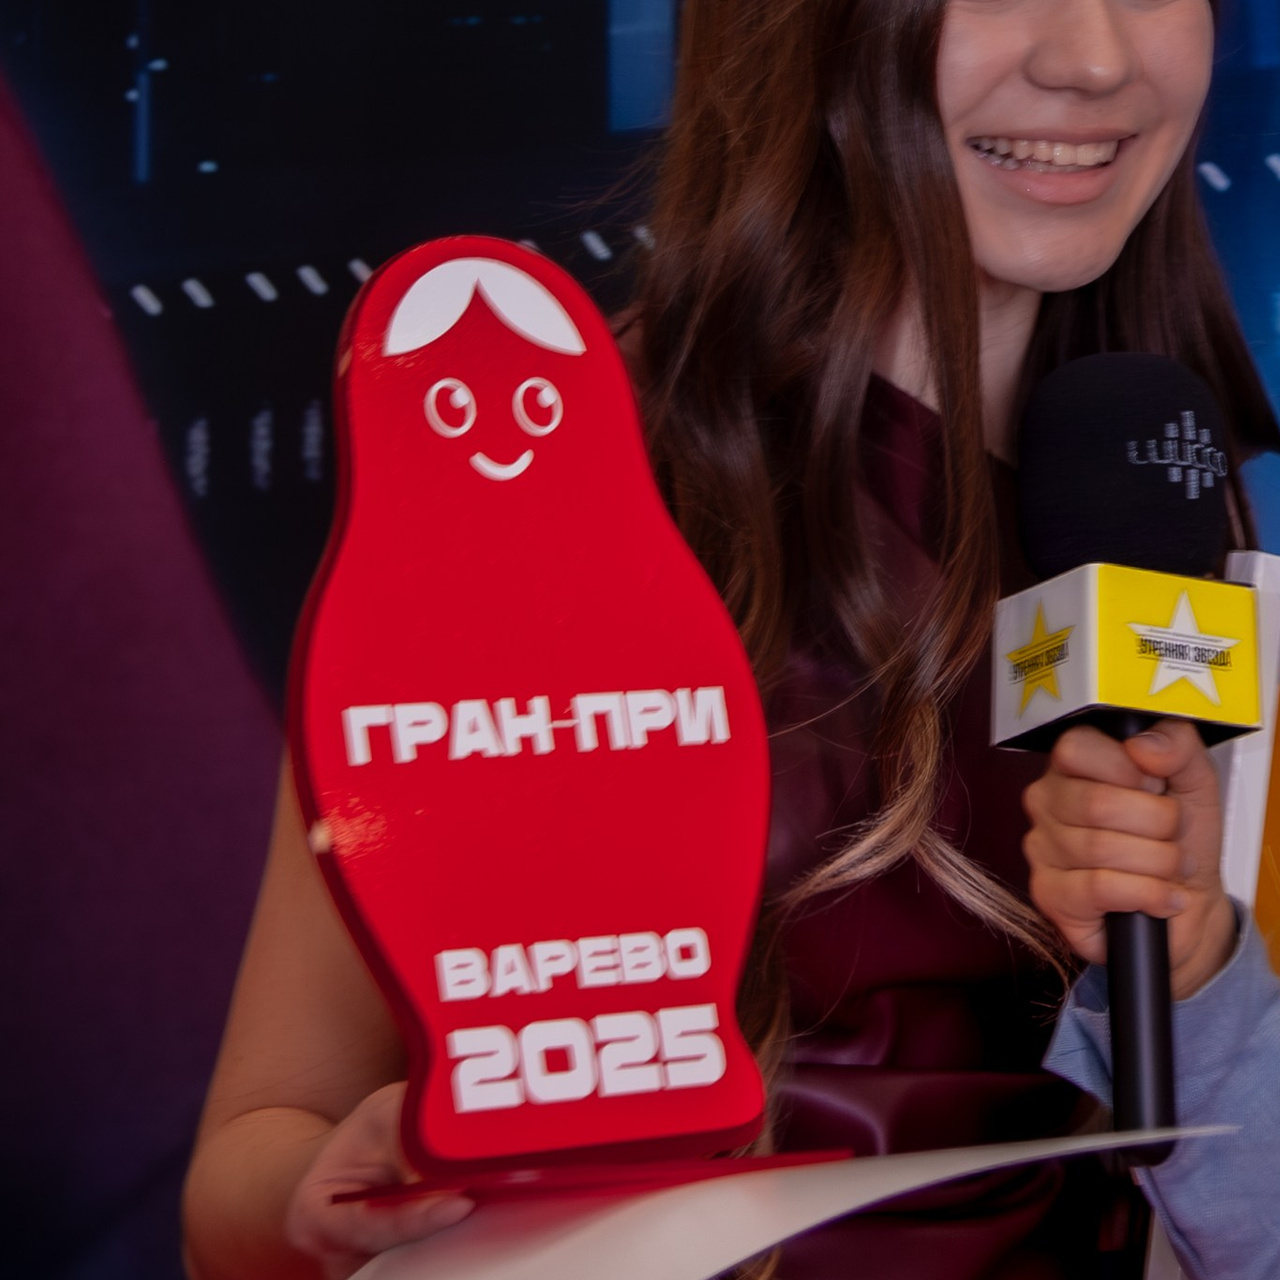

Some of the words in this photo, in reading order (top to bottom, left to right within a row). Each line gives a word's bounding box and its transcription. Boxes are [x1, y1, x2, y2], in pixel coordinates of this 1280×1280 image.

[341, 686, 731, 767] ГРАН-ПРИ
[434, 927, 712, 1003] ВАРЕВО
[446, 1003, 728, 1114] 2025
